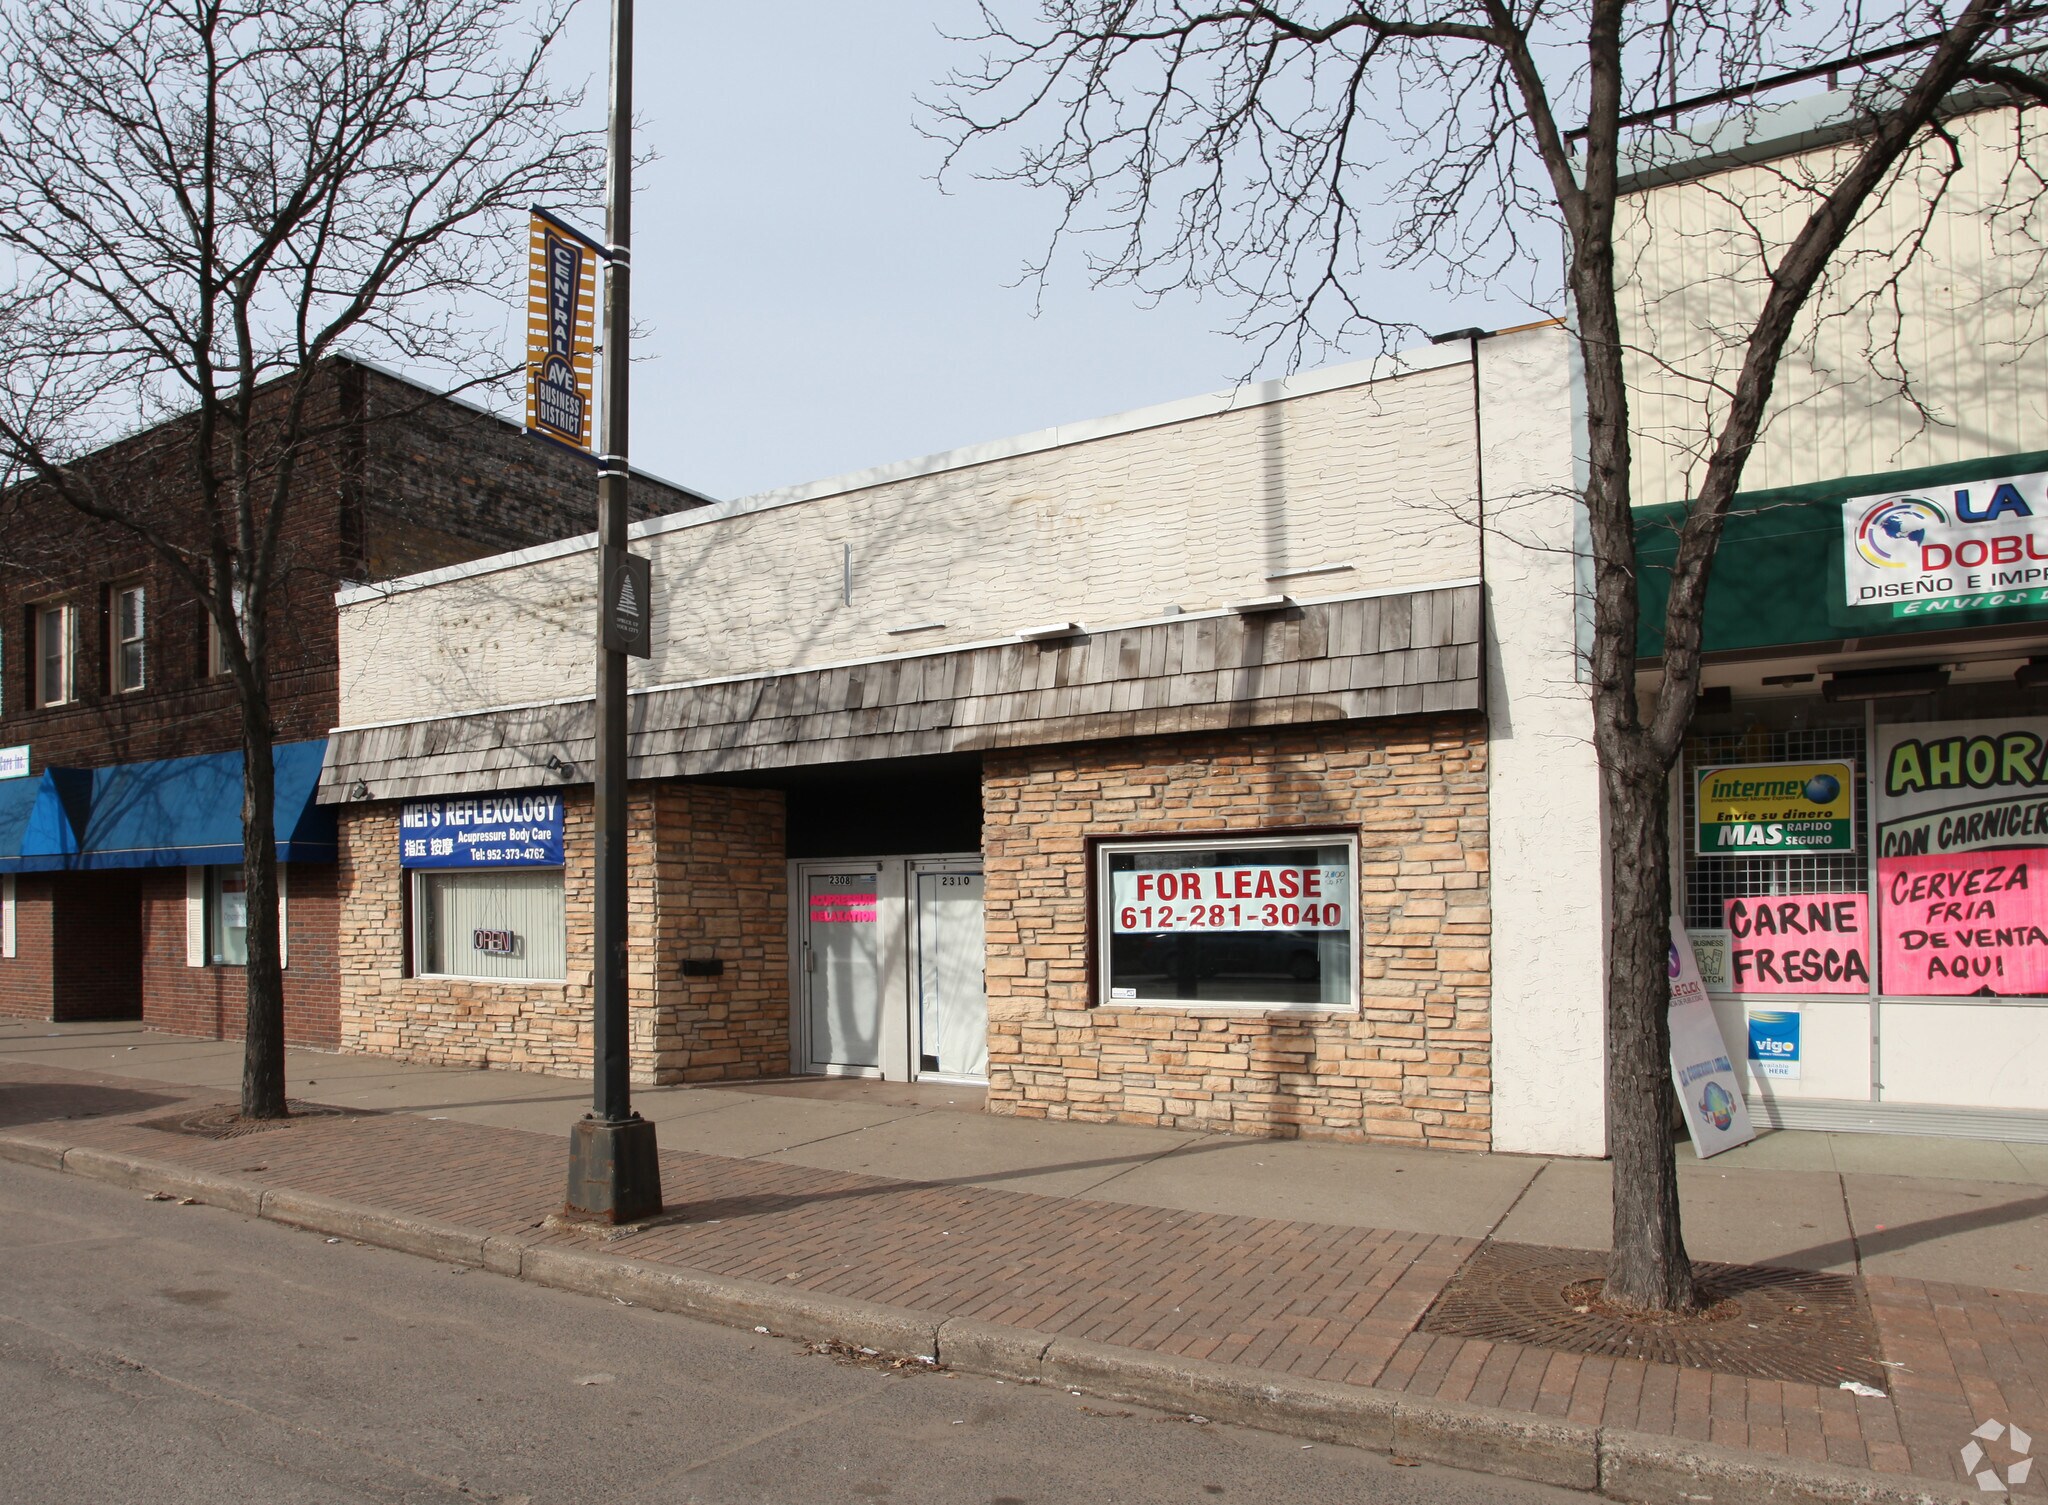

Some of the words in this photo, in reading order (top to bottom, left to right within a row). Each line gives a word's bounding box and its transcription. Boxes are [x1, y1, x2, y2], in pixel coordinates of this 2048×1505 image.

[554, 247, 570, 355] CENTRAL
[548, 362, 573, 391] AVE
[540, 382, 580, 417] BUSINESS
[540, 404, 579, 435] DISTRICT
[1954, 483, 2033, 524] LA
[1860, 574, 1953, 600] DISEÑO
[1967, 575, 1981, 589] E
[1903, 592, 2027, 614] ENVIOS
[1711, 779, 1812, 799] intermex
[403, 802, 441, 828] MEI'S
[446, 795, 557, 826] REFLEXOLOGY
[1717, 811, 1756, 822] Envie
[1761, 812, 1777, 820] su
[1782, 809, 1833, 819] dinero
[458, 830, 506, 845] Acupressure
[509, 828, 530, 843] Body
[531, 827, 551, 840] Care
[1717, 823, 1782, 846] MAS
[1787, 822, 1832, 831] RAPIDO
[1785, 835, 1832, 845] SEGURO
[1884, 824, 1930, 858] CON
[471, 848, 485, 861] Tel:
[487, 848, 545, 860] 952-373-4762
[829, 876, 850, 885] 2308
[942, 876, 970, 886] 2310
[1137, 873, 1202, 901] FOR
[1215, 869, 1321, 899] LEASE
[1891, 863, 2028, 905] CERVEZA
[1121, 903, 1341, 929] 612-281-3040
[1729, 900, 1858, 938] CARNE
[1926, 900, 1995, 925] FRIA
[474, 930, 510, 951] OPEN
[1899, 930, 1949, 950] DE
[1955, 926, 2048, 948] VENTA
[1732, 948, 1869, 984] FRESCA
[1928, 955, 2004, 980] AQUI
[1755, 1038, 1794, 1053] vigo
